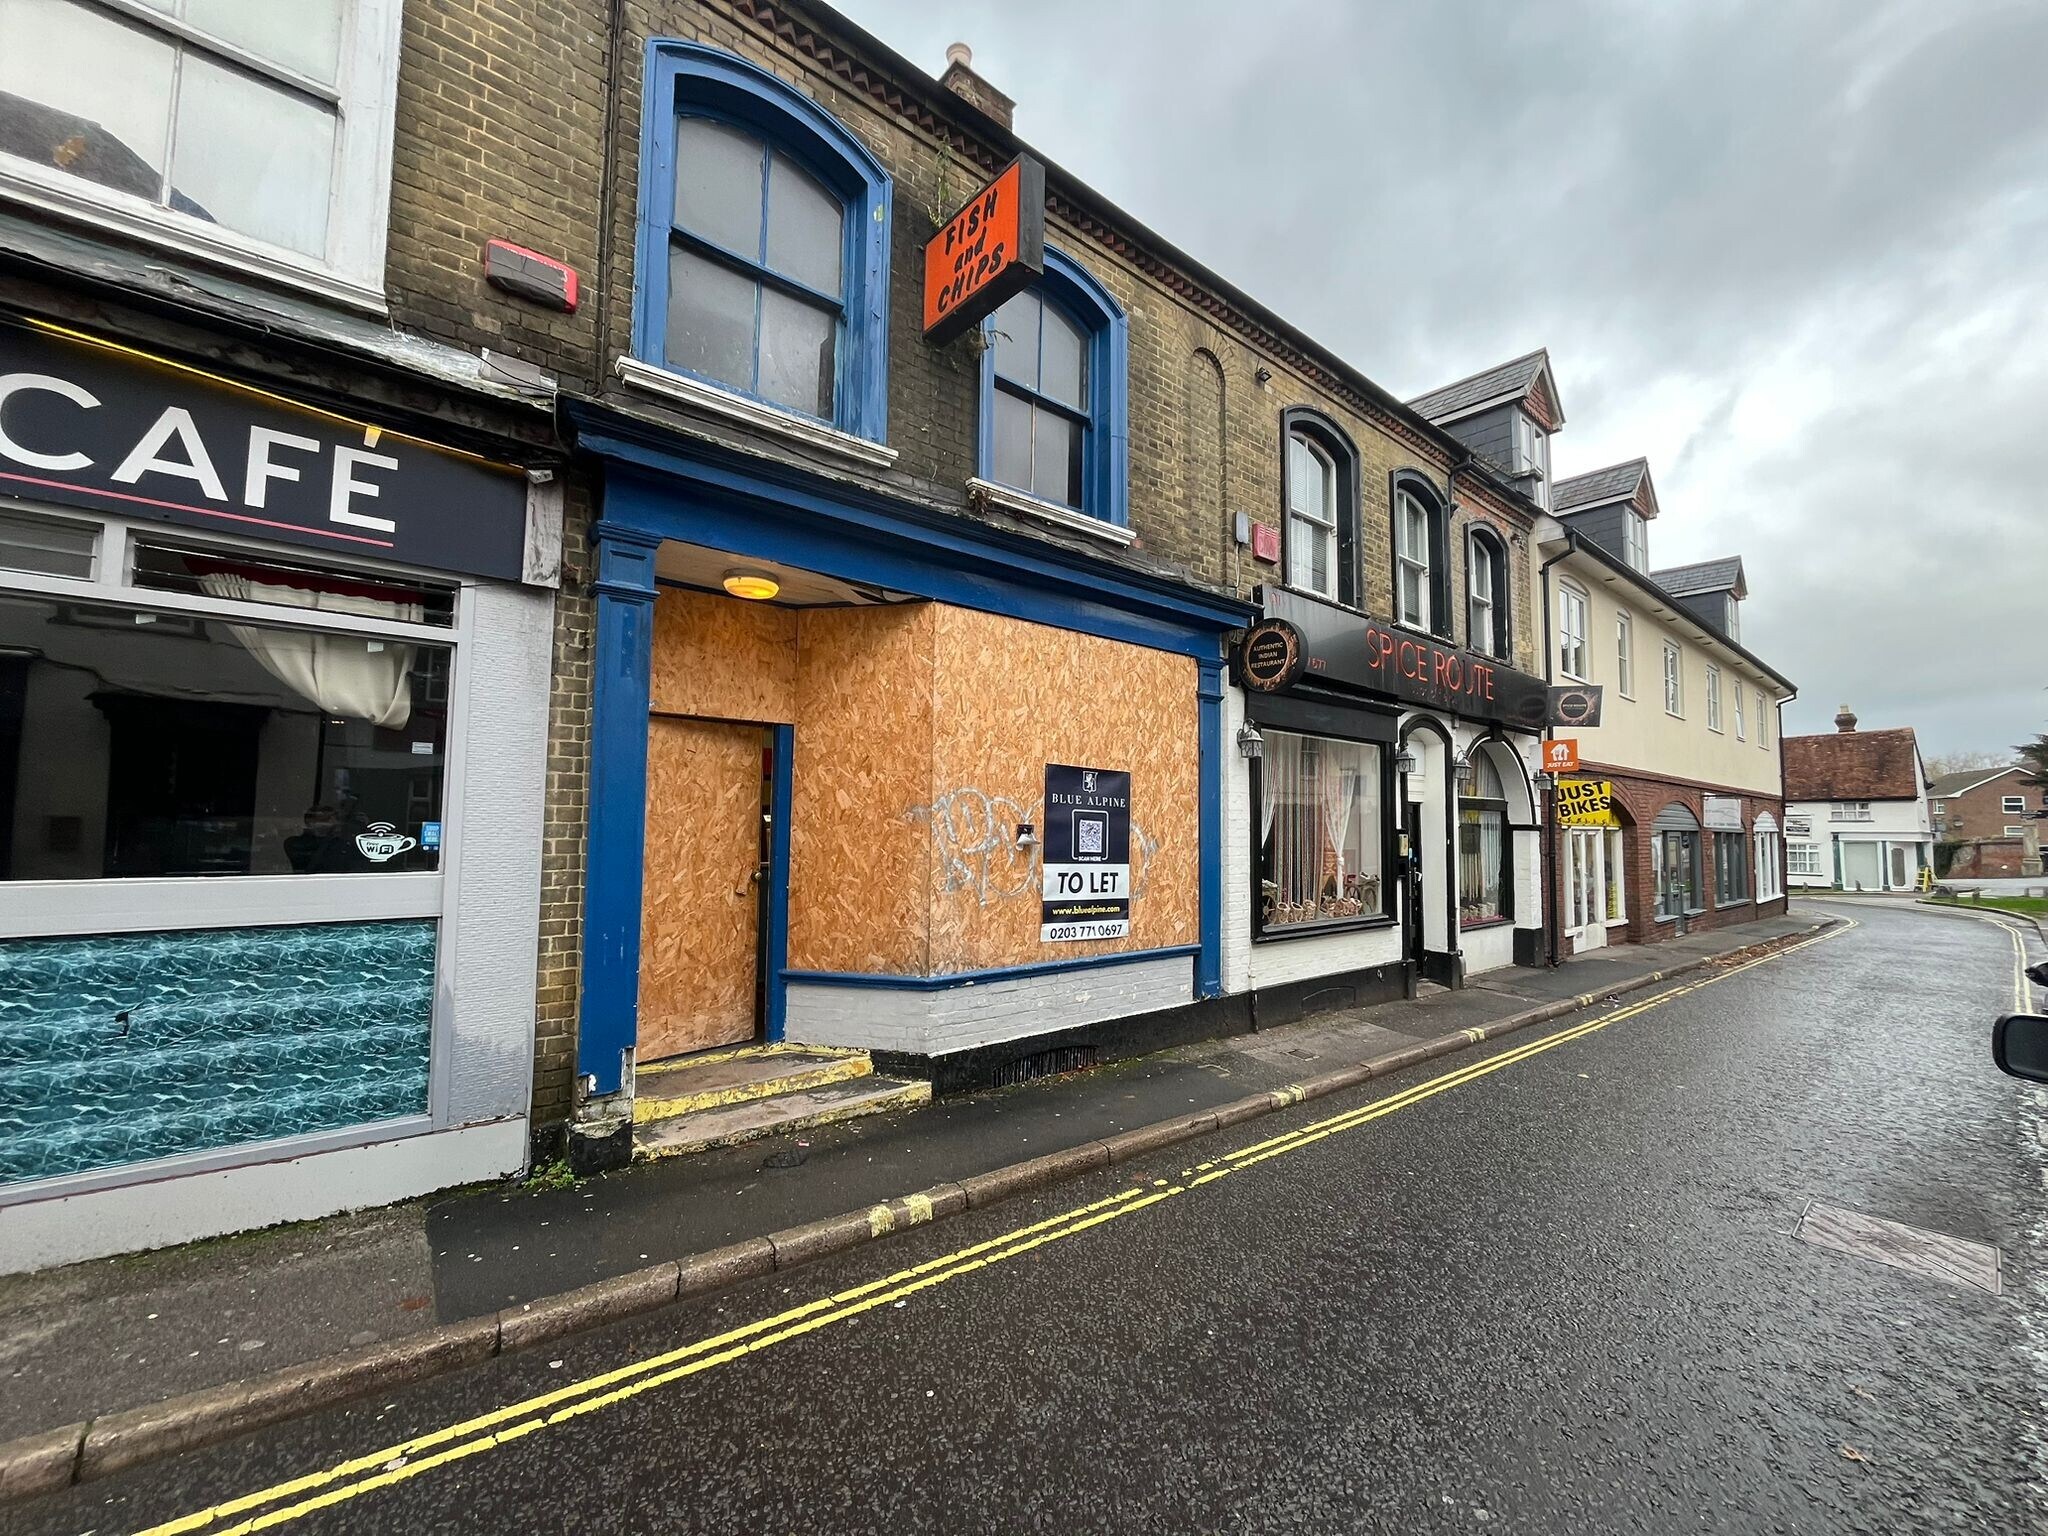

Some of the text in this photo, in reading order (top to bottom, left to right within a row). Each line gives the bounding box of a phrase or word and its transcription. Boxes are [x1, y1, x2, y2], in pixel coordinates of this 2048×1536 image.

[944, 187, 998, 256] FISH
[953, 225, 987, 274] and
[937, 242, 1004, 313] CHIPS
[0, 372, 399, 534] CAFÉ
[1253, 641, 1284, 652] AUTHENTIC
[1258, 651, 1278, 659] INDIAN
[1251, 658, 1286, 669] RESTAURANT
[1366, 629, 1494, 701] SPICE ROUTE
[1052, 793, 1126, 808] BLUE ALPINE
[1558, 781, 1603, 802] JUST
[1559, 796, 1610, 817] BIKES
[1057, 872, 1119, 894] TO LET
[1052, 905, 1120, 916] www.bluealpine.com
[1050, 924, 1122, 939] 0203 771 0697
